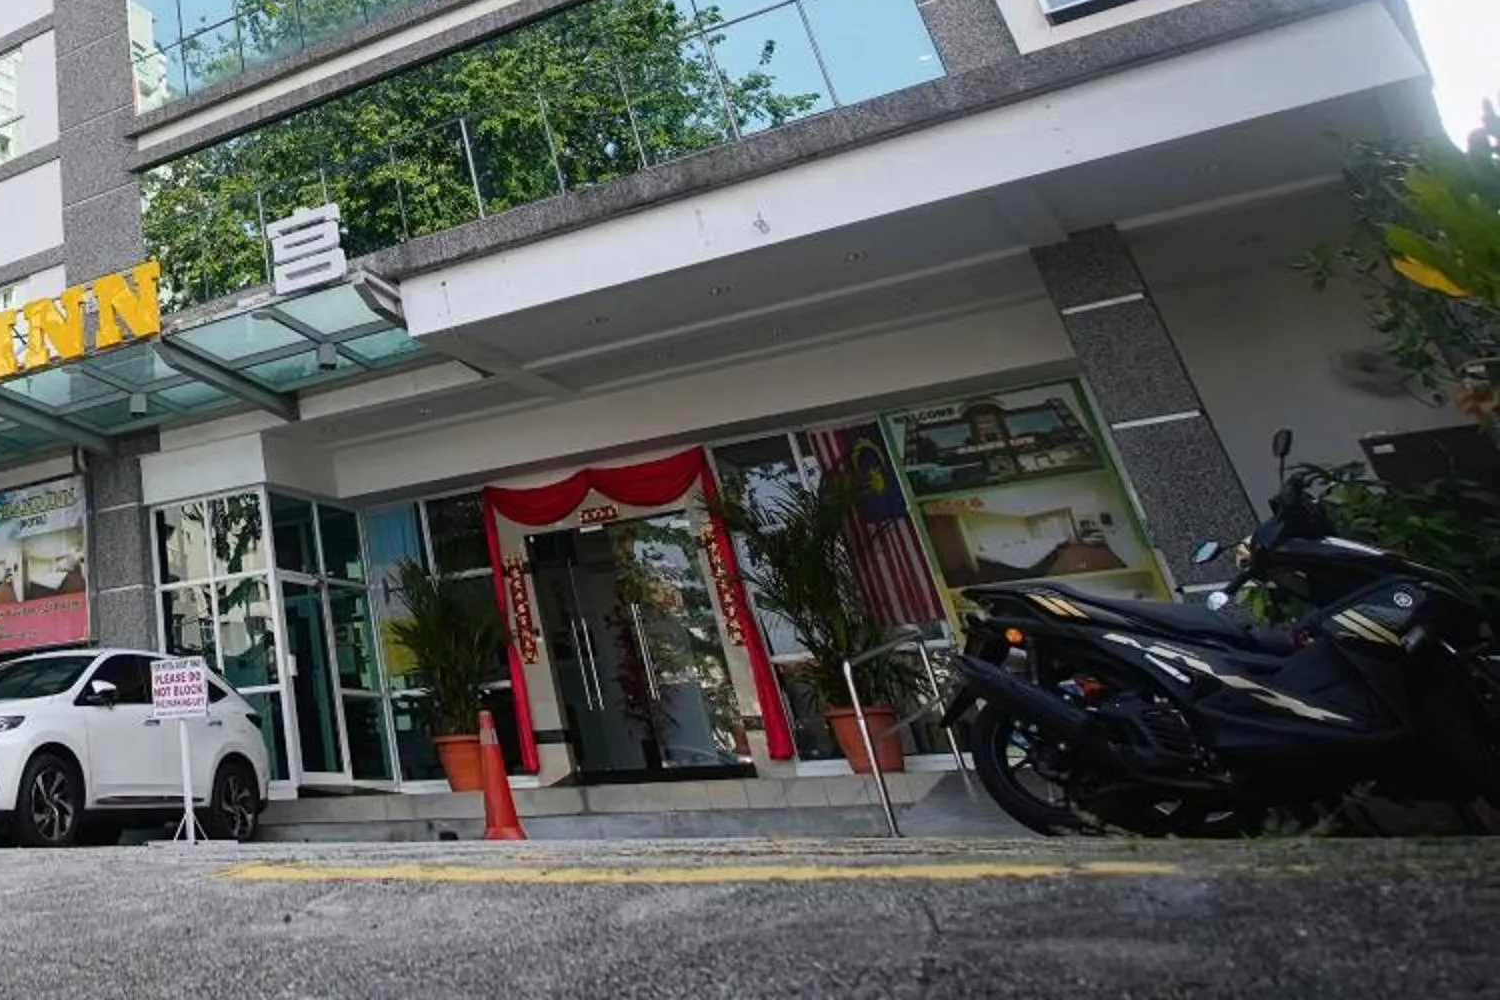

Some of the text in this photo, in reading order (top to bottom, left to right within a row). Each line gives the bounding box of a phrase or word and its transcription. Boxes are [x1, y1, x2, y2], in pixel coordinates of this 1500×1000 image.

[155, 670, 201, 685] PLEASE DO
[153, 684, 202, 697] NOT BLOCK
